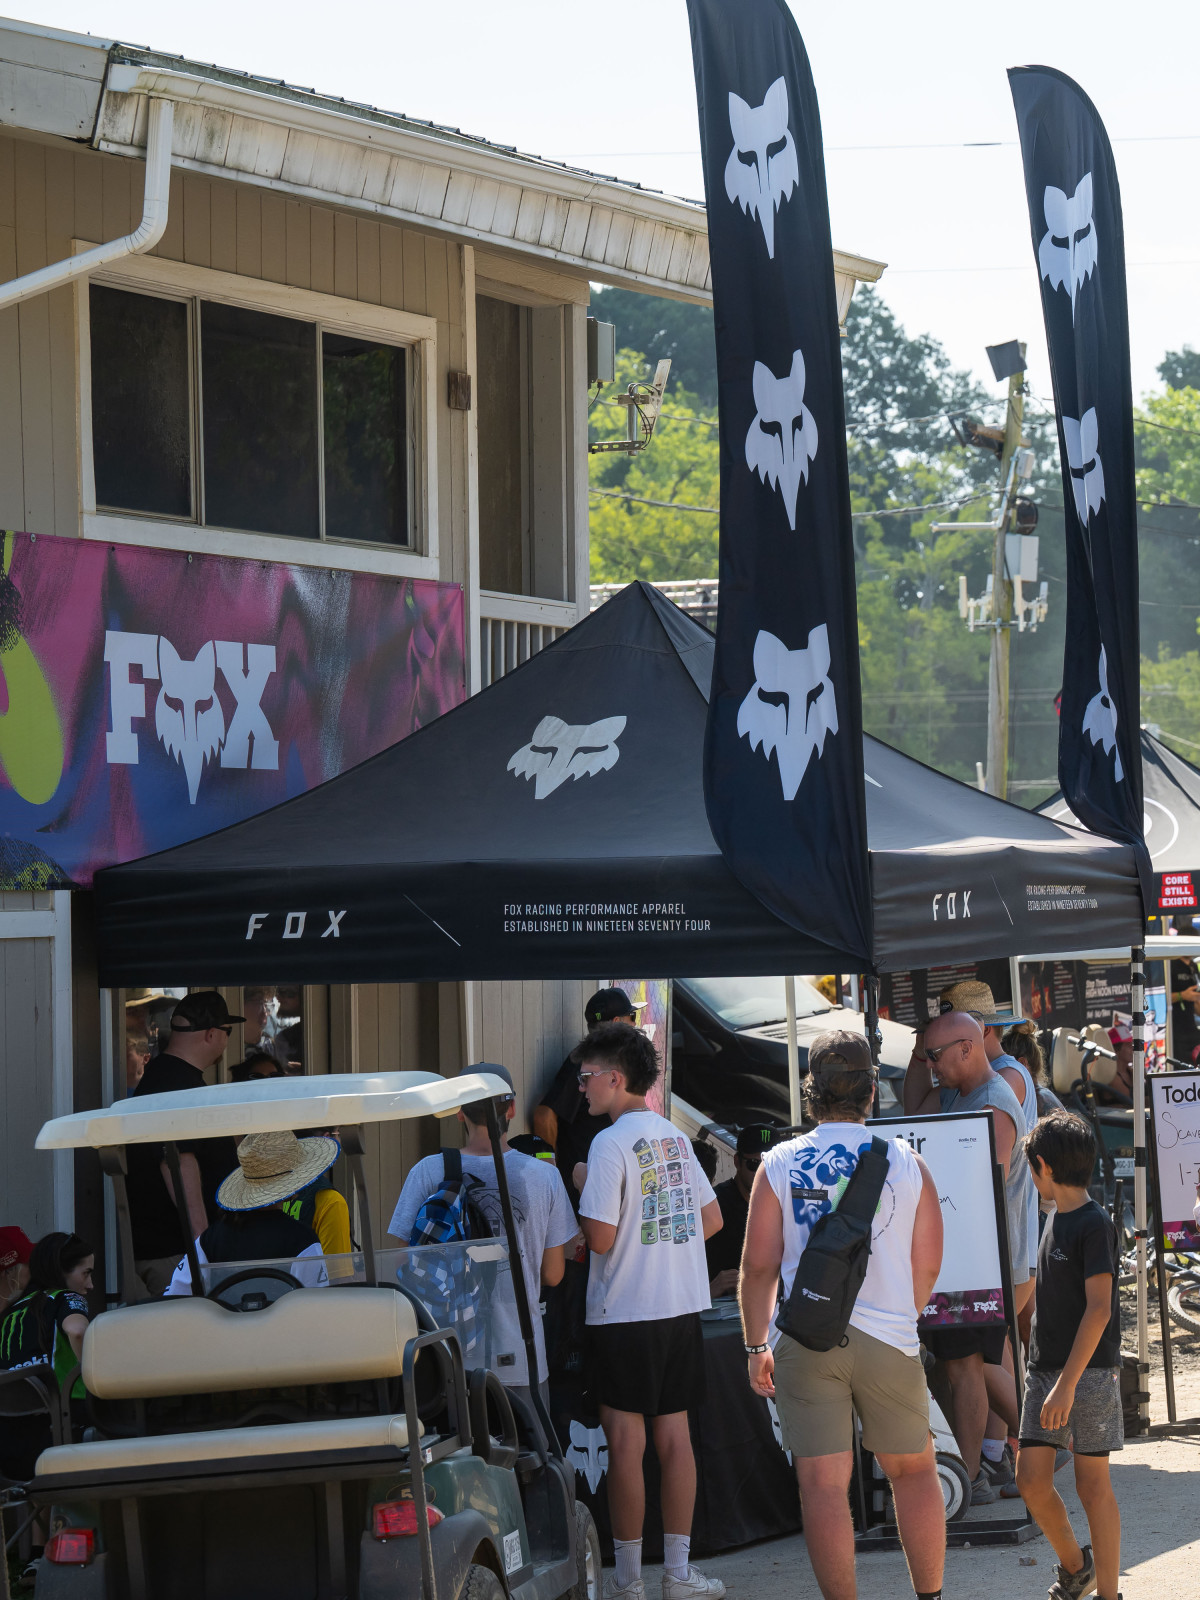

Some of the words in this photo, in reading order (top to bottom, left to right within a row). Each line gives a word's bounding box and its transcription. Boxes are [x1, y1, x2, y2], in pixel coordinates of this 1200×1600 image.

[1165, 876, 1189, 885] CORE
[1164, 886, 1190, 896] STILL
[932, 890, 971, 921] FOX
[1162, 897, 1194, 906] EXISTS
[504, 904, 522, 915] FOX
[525, 904, 562, 915] RACING
[565, 903, 639, 915] PERFORMANCE
[642, 903, 686, 915] APPAREL
[245, 910, 347, 940] FOX
[504, 920, 569, 932] ESTABLISHED
[573, 921, 583, 932] IN
[586, 920, 634, 932] NINETEEN
[637, 920, 681, 931] SEVENTY
[685, 919, 711, 931] FOUR
[1167, 1231, 1186, 1243] FOX
[973, 1300, 999, 1314] FOX
